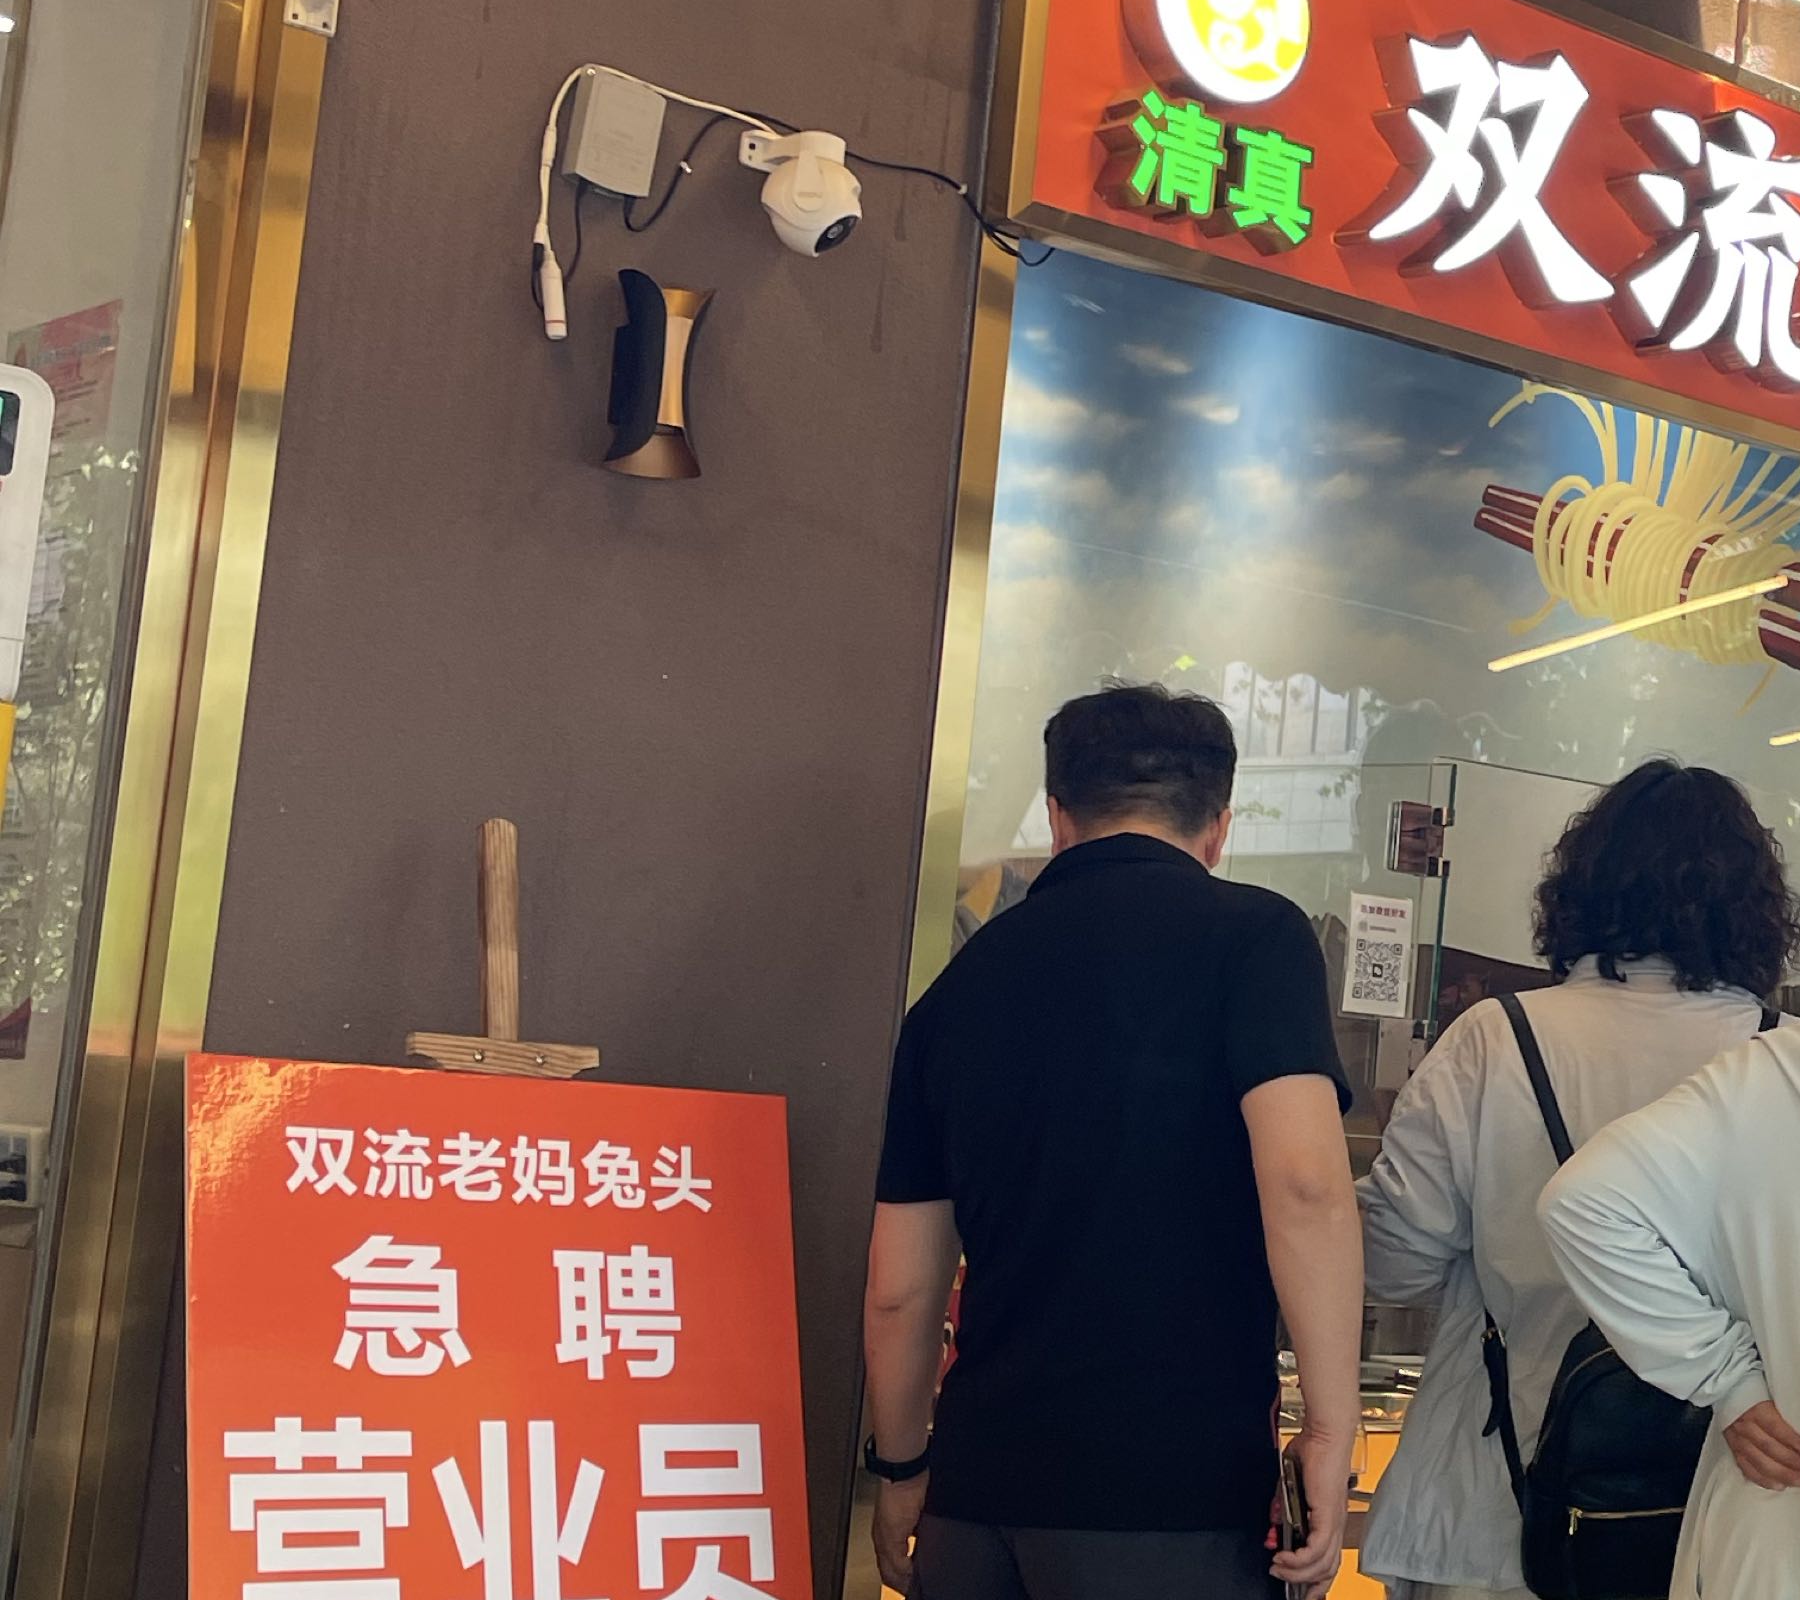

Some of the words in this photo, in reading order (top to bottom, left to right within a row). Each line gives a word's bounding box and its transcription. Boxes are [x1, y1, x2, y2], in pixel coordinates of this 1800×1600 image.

[1131, 90, 1313, 245] 清真
[284, 1124, 714, 1213] 双流老妈兔头
[332, 1234, 684, 1381] 急聘
